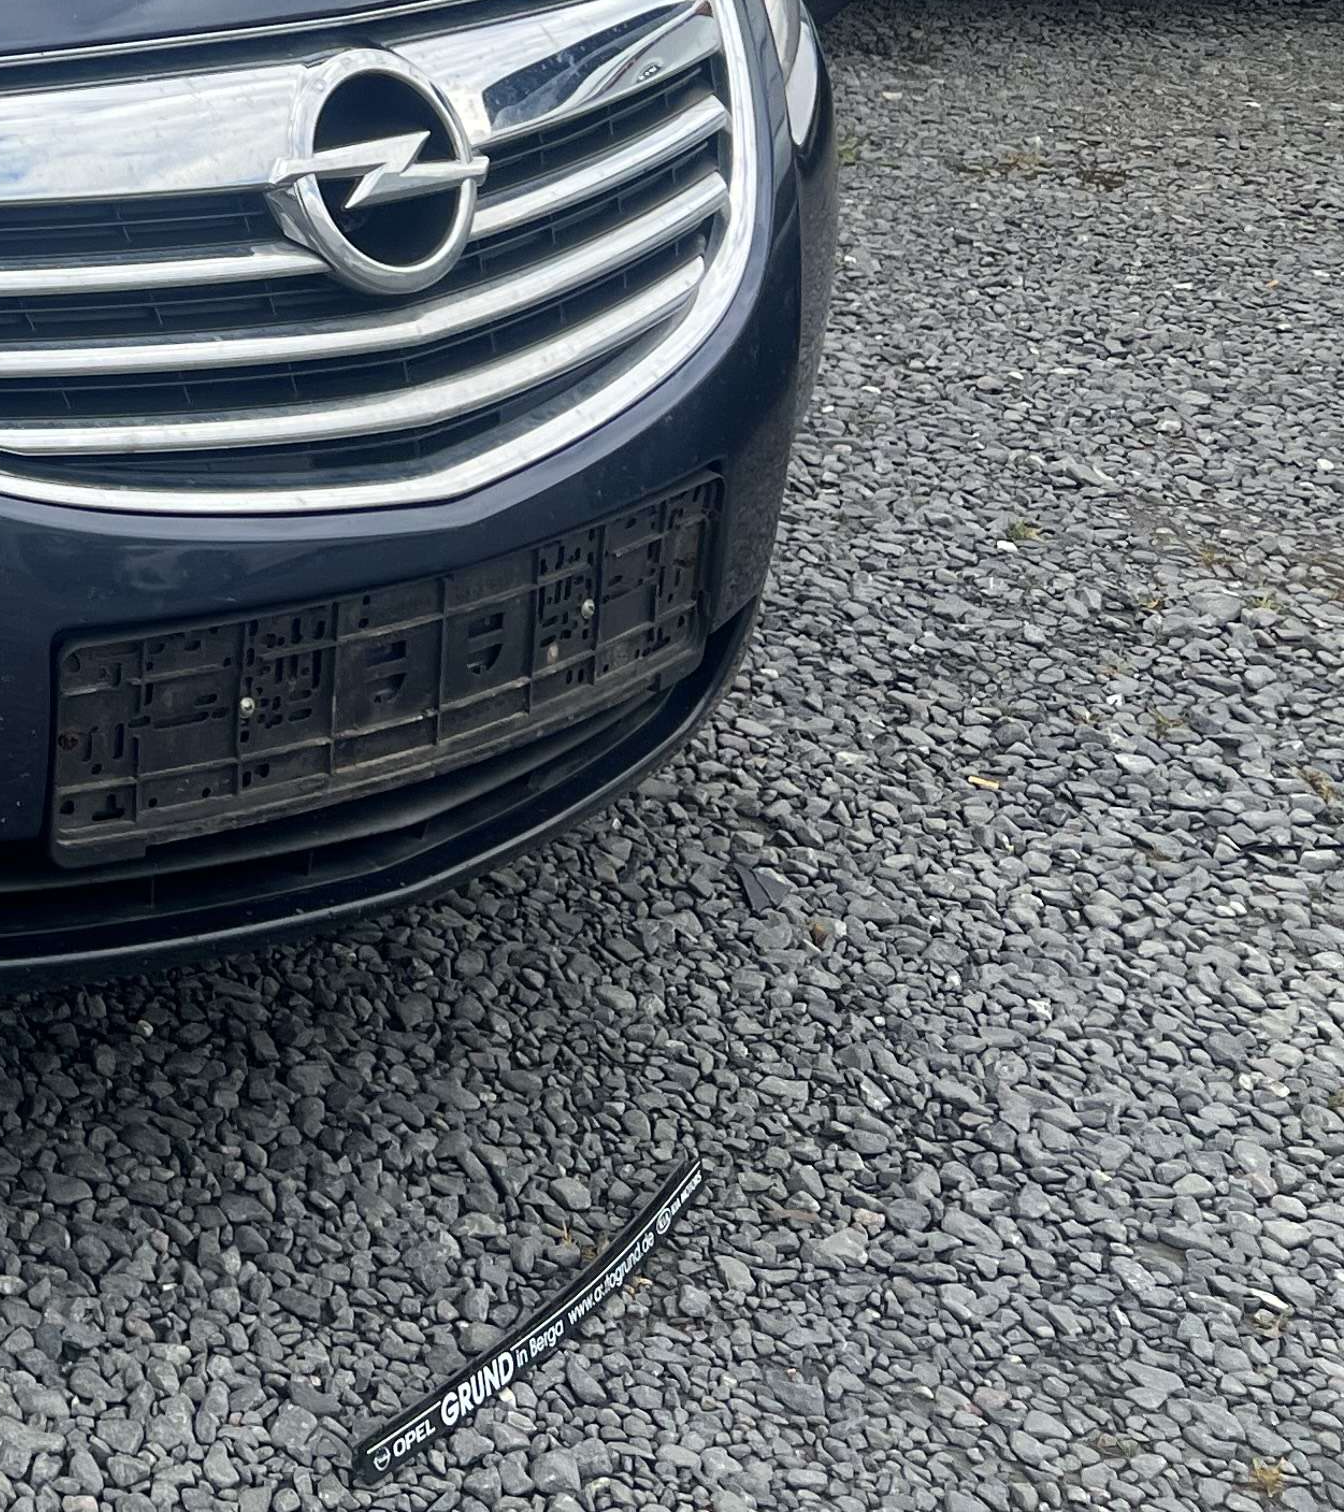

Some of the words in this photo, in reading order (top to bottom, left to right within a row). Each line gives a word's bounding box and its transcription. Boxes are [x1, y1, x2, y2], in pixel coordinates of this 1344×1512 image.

[393, 1419, 436, 1457] OPEL
[441, 1351, 513, 1425] GRUND
[515, 1347, 529, 1368] in
[529, 1320, 564, 1358] Berga
